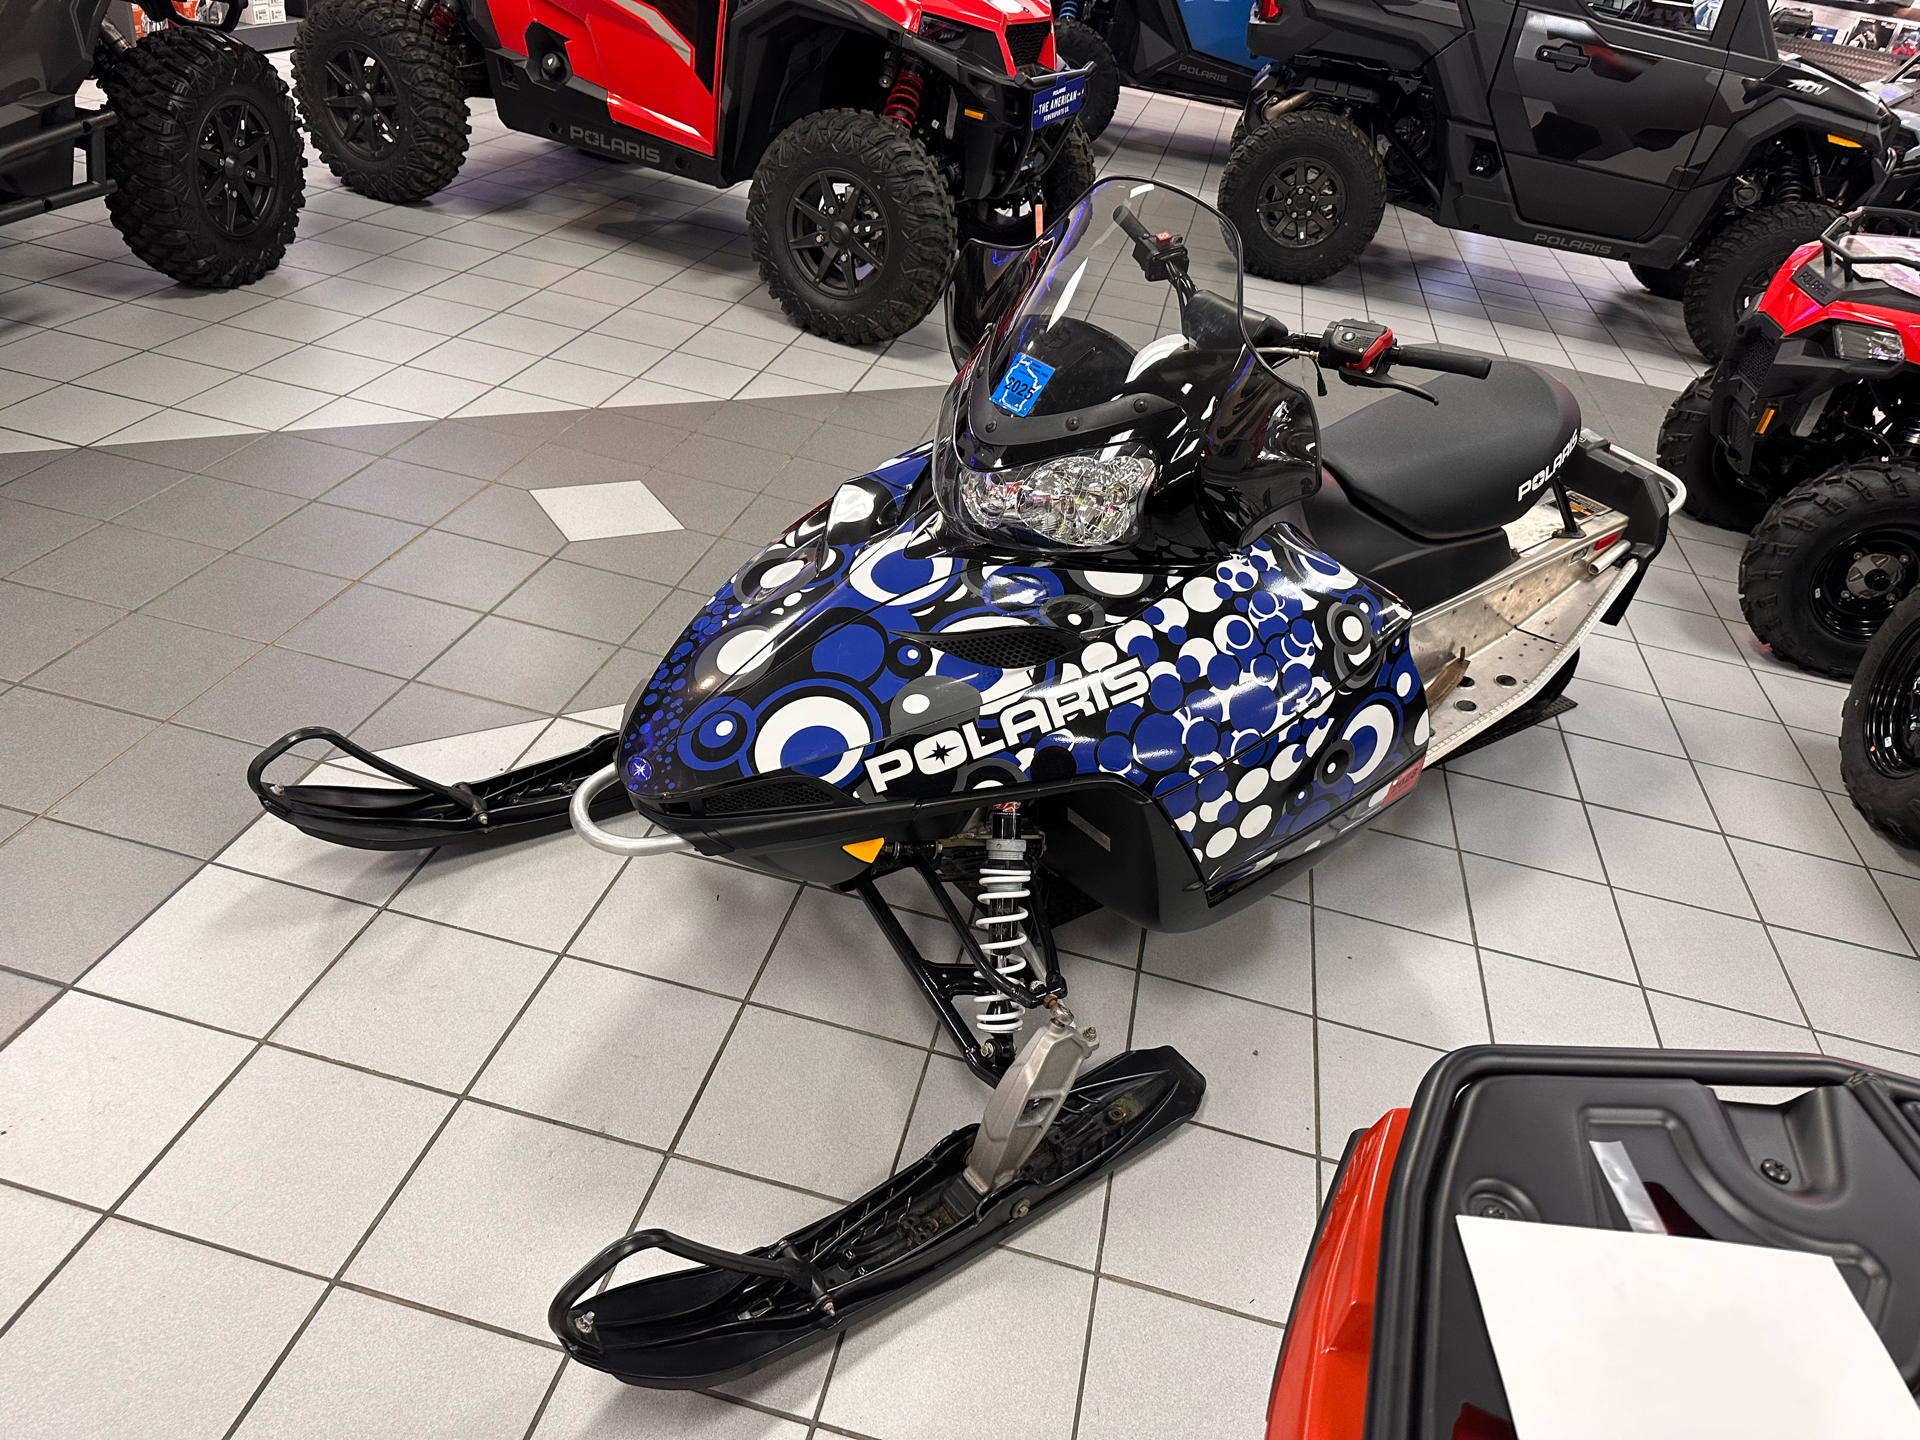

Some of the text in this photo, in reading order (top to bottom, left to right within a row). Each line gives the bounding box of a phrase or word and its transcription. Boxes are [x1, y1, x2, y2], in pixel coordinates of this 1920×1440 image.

[1179, 64, 1228, 83] POLARIS
[1787, 79, 1830, 96] ADV
[1038, 90, 1077, 115] THE AMERICAN
[570, 125, 660, 164] POLARIS
[1534, 233, 1612, 255] POLARIS
[1799, 271, 1831, 298] POLARIS
[1004, 376, 1036, 400] 2025
[1518, 428, 1578, 502] POLARIS
[864, 657, 1150, 793] POLARIS
